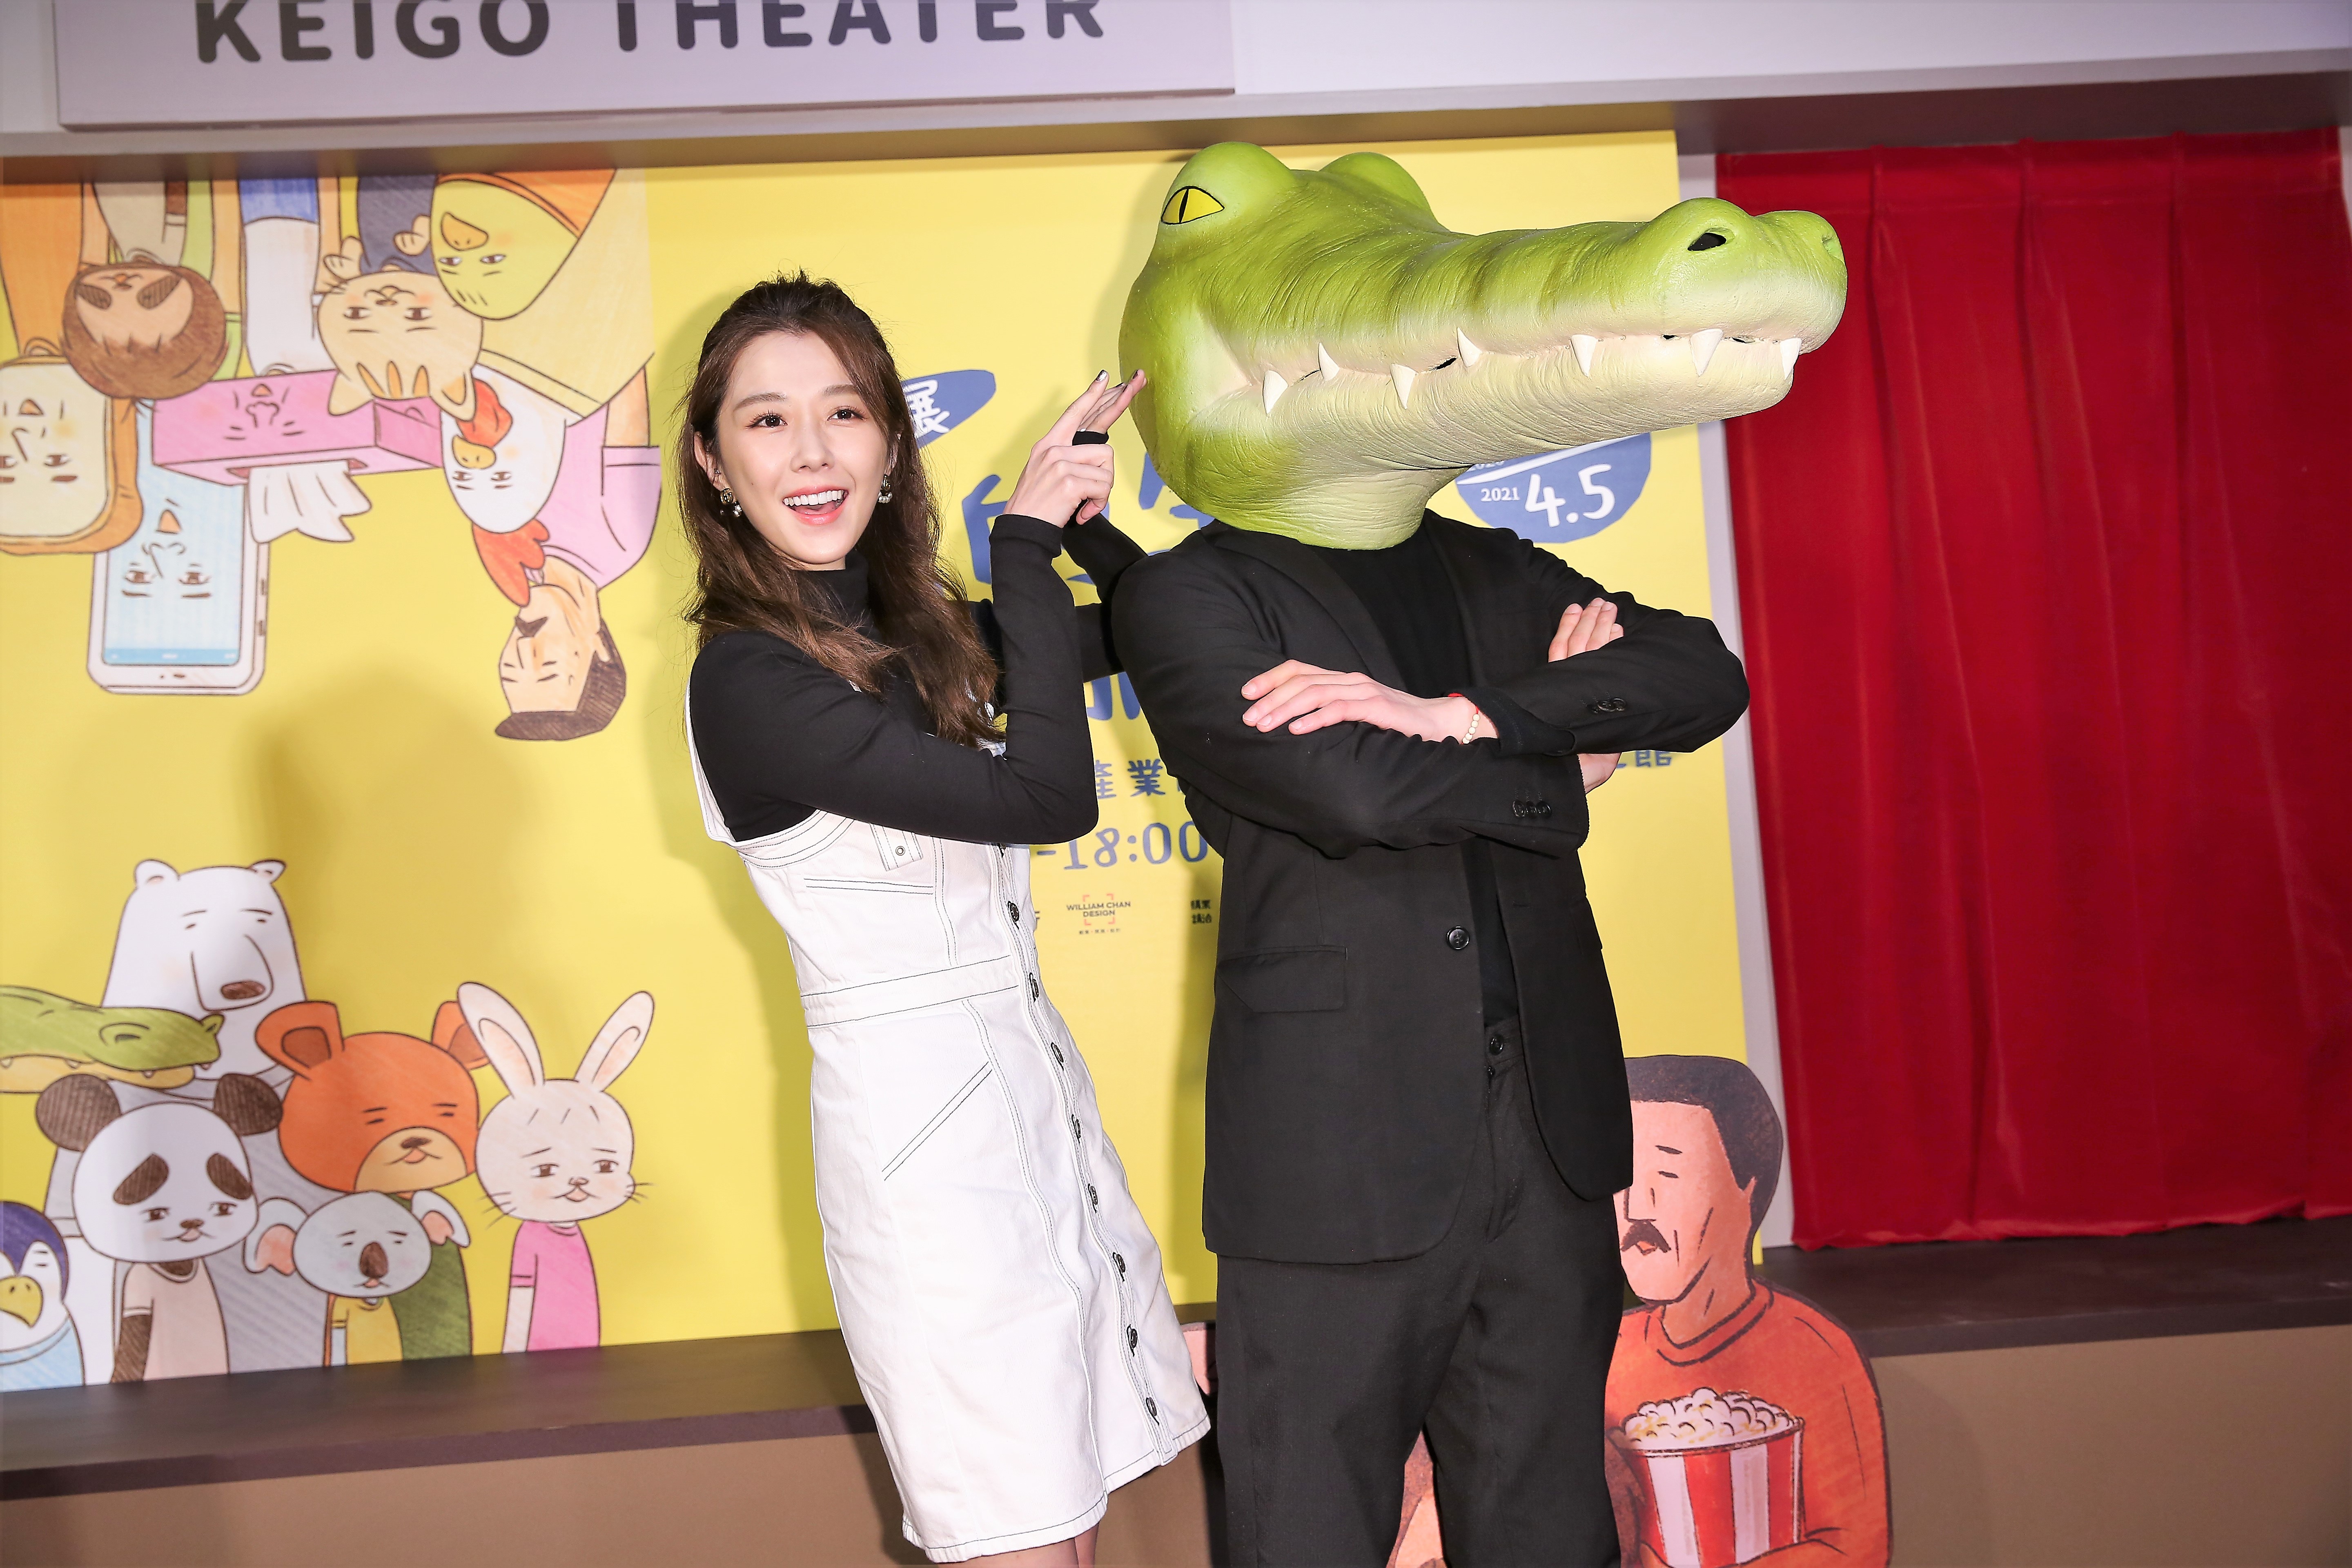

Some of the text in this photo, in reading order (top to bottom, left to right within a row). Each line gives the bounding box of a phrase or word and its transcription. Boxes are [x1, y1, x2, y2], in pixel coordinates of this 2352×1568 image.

[195, 0, 1103, 63] KEIGO THEATER
[1481, 463, 1615, 528] 2021 4.5
